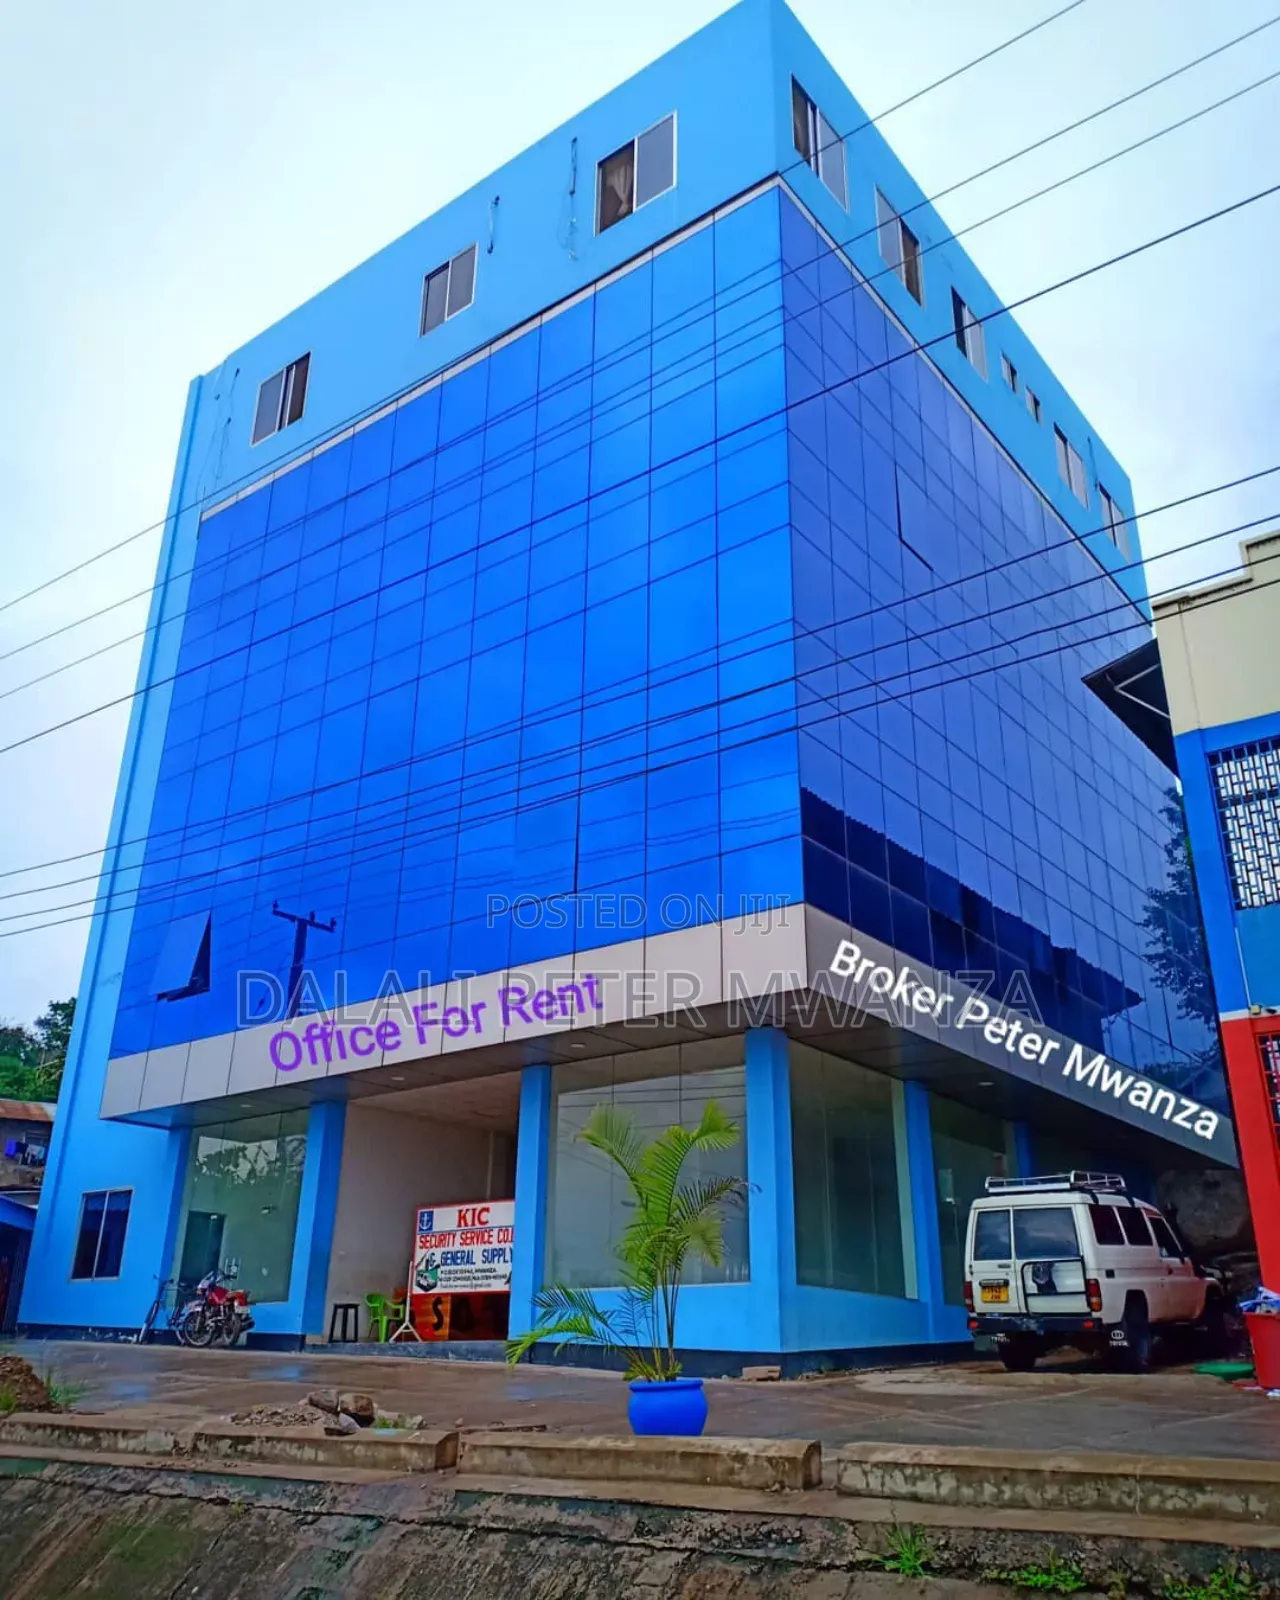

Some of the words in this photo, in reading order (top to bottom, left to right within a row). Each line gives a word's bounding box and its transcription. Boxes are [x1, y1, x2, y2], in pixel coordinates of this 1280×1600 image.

[457, 1208, 490, 1228] KIC
[419, 1233, 456, 1249] SECURITY
[460, 1229, 493, 1246] SERVICE
[441, 1249, 476, 1267] GENERAL
